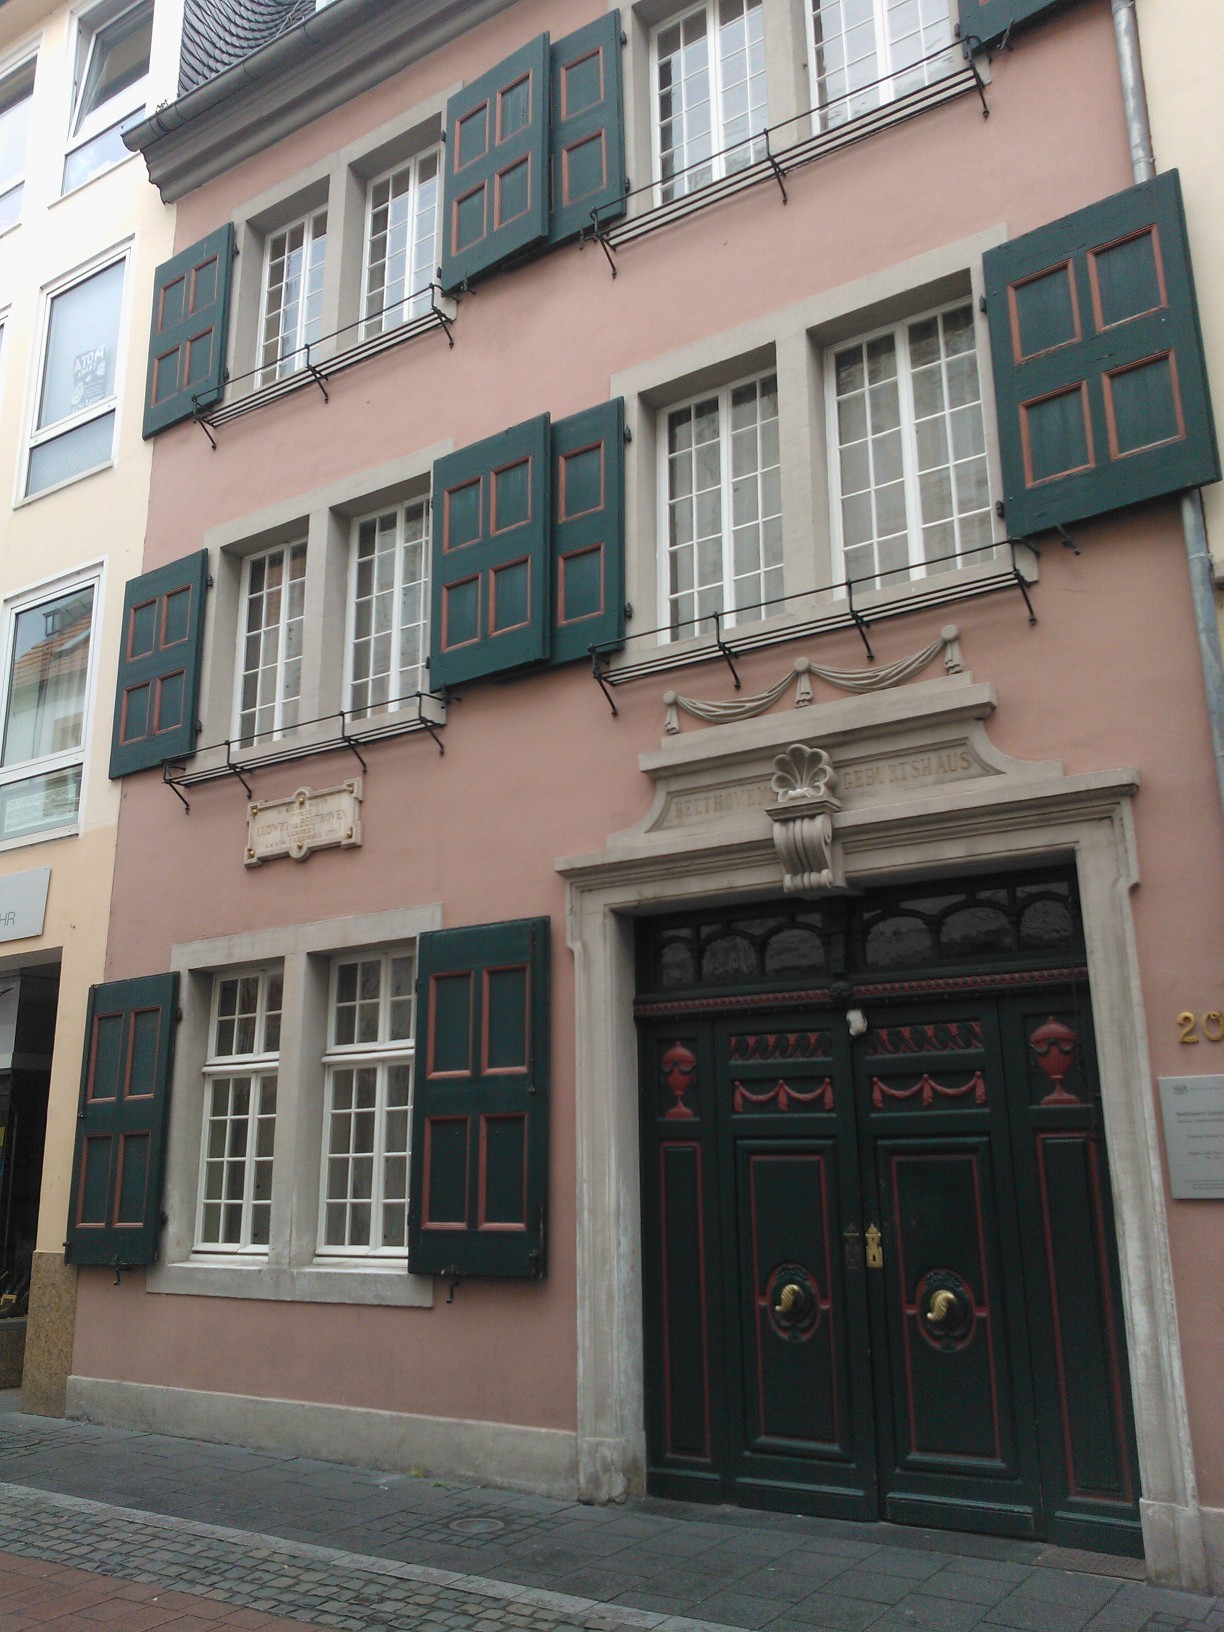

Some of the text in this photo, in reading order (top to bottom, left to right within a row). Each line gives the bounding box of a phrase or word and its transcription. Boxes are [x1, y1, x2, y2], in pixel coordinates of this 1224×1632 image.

[74, 343, 105, 372] ATOM
[843, 751, 971, 790] GEBURTSHAUS
[1177, 1011, 1224, 1044] 20
